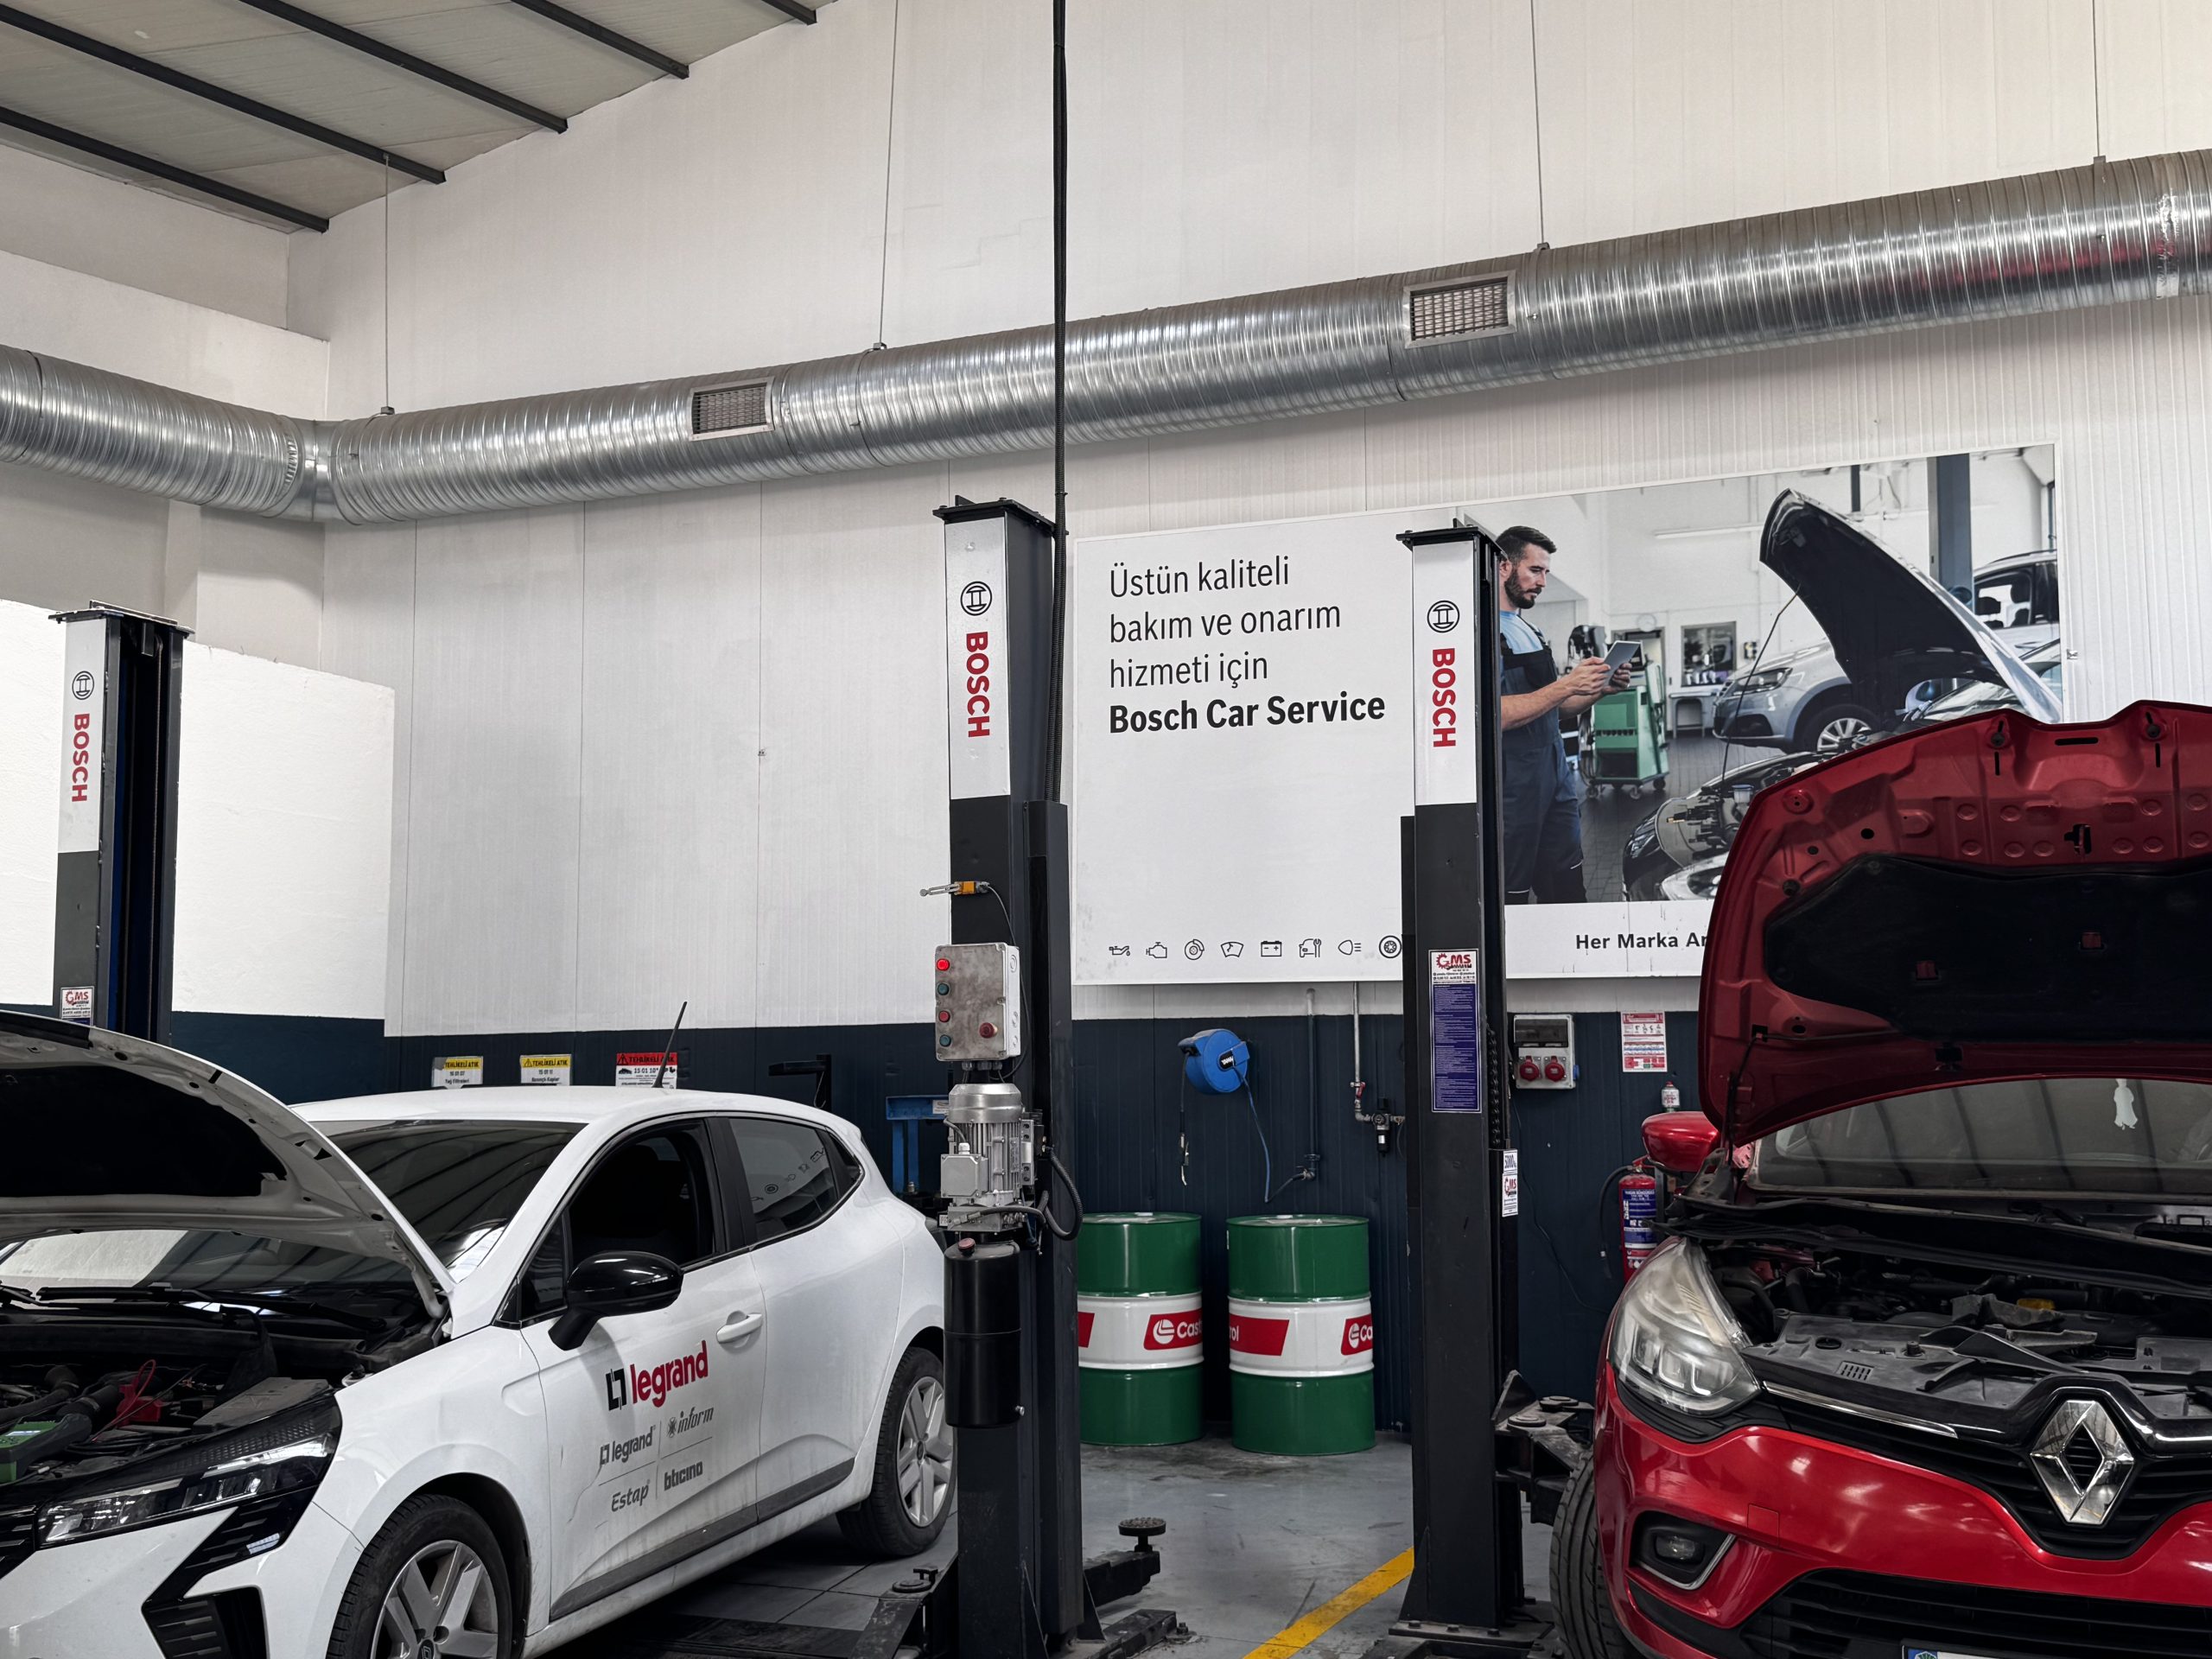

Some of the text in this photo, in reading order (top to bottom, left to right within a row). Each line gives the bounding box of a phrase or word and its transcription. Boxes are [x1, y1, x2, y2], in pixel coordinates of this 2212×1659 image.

[1110, 555, 1288, 597] Üstün kaliteli
[1110, 606, 1340, 643] bakım ve onarım
[966, 632, 991, 738] BOSCH
[1110, 651, 1268, 689] hizmeti için
[1109, 690, 1385, 734] Bosch Car Service
[1432, 648, 1457, 747] BOSCH
[72, 714, 90, 802] BOSCH
[1576, 934, 1611, 950] Her
[1618, 932, 1678, 949] Marka
[1436, 952, 1471, 969] GMS
[66, 991, 89, 1005] GMS
[629, 1339, 709, 1408] legrand
[677, 1406, 714, 1434] inform
[611, 1426, 653, 1463] legrand
[664, 1461, 703, 1491] bticino
[611, 1484, 649, 1512] Estap
